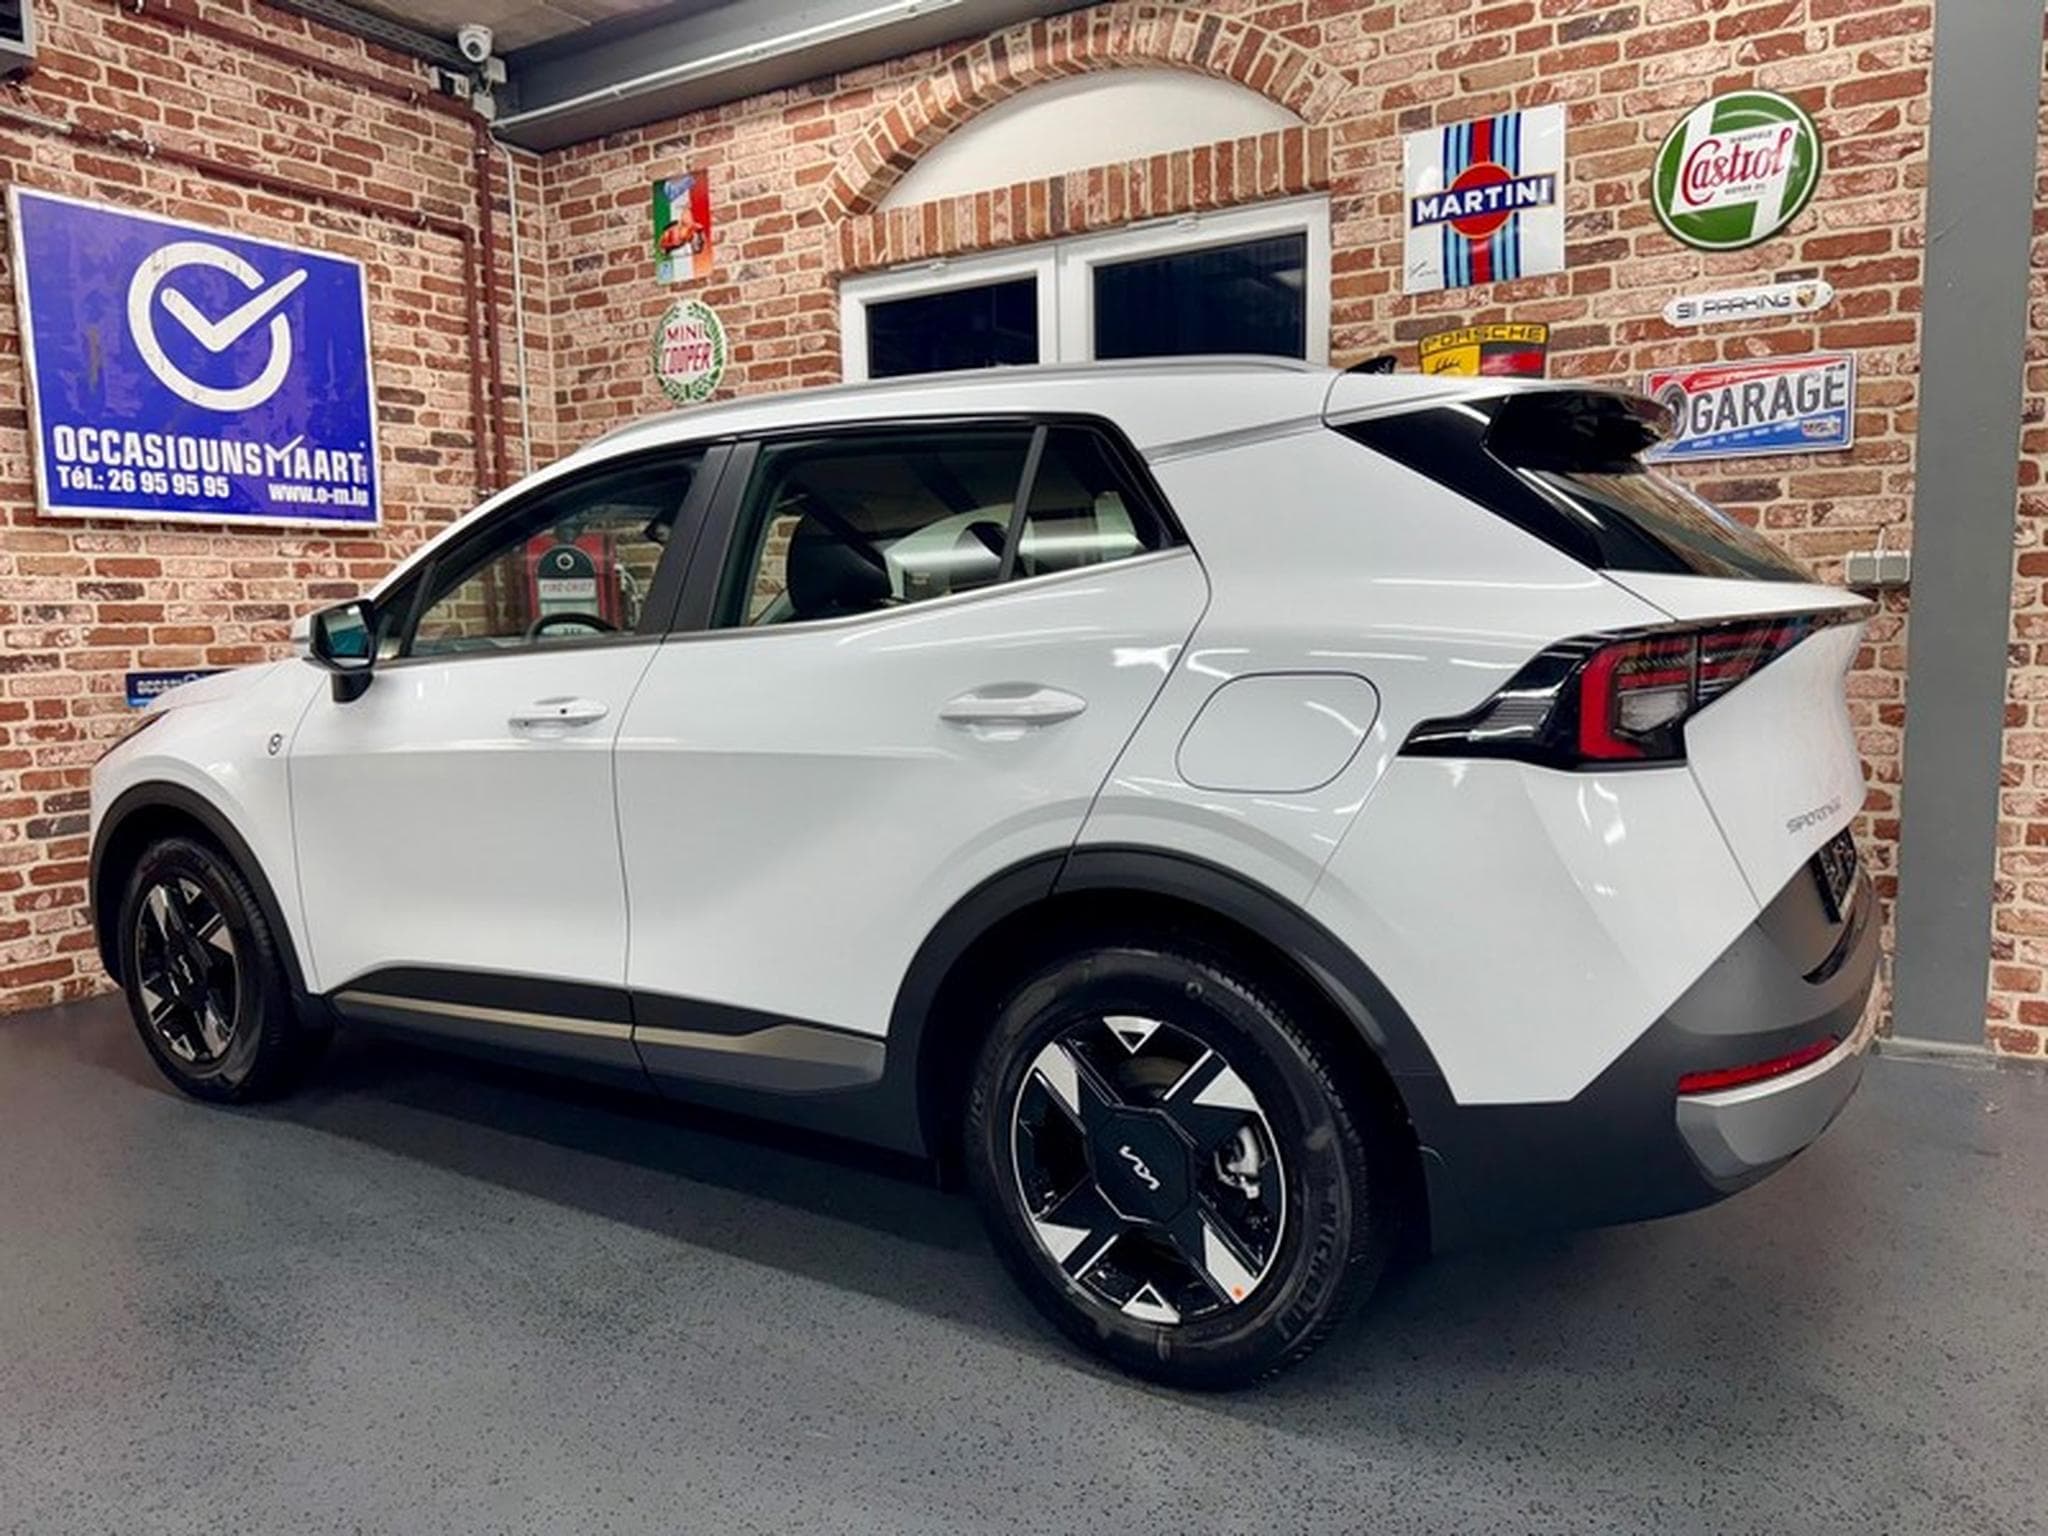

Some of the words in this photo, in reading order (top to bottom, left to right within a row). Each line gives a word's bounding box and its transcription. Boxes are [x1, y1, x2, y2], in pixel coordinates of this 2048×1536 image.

[1682, 126, 1794, 207] Castrol
[1416, 177, 1550, 223] MARTINI
[1702, 293, 1791, 315] PARKING
[667, 322, 705, 341] MINI
[1423, 326, 1541, 352] PORSCHE
[662, 342, 712, 375] COOPER
[1690, 363, 1848, 436] GARAGE
[107, 468, 137, 493] 26
[139, 470, 169, 495] 95
[172, 473, 201, 497] 95
[202, 475, 231, 499] 95
